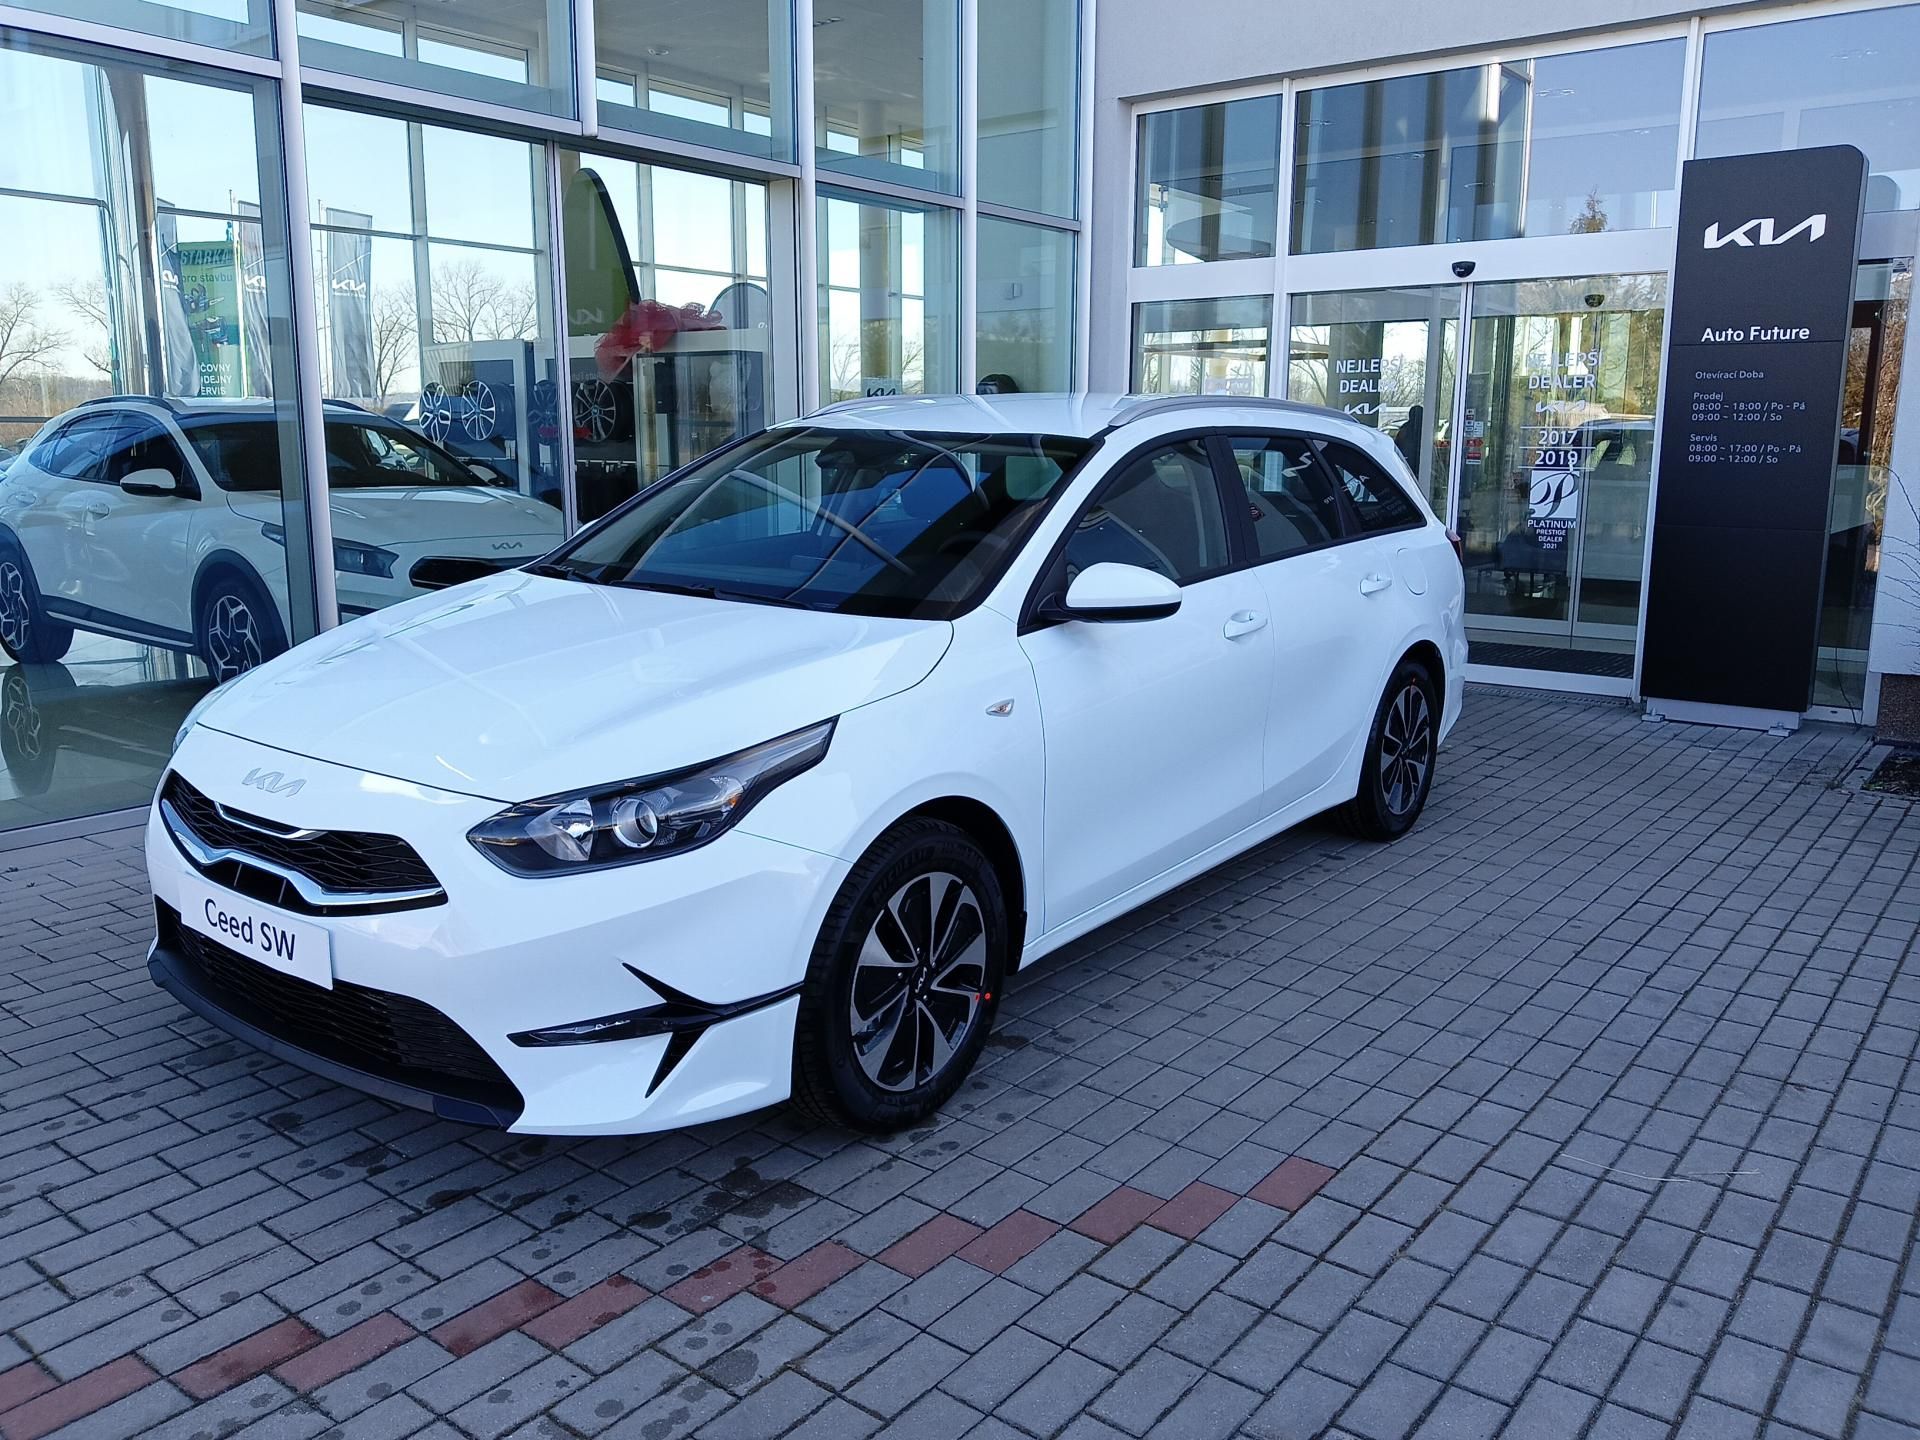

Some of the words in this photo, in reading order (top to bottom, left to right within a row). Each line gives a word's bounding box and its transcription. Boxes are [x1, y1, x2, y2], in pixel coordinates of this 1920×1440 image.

[1704, 214, 1827, 249] KIA
[332, 279, 367, 292] KIA
[1701, 328, 1745, 342] Auto
[1749, 326, 1810, 341] Future
[1695, 371, 1737, 380] Otevírací
[1739, 370, 1765, 379] Doba
[1528, 374, 1596, 390] DEALER
[1693, 392, 1724, 402] Prodej
[1344, 402, 1388, 415] KIA
[1692, 402, 1721, 411] 08:00
[1732, 402, 1761, 411] 18:00
[1771, 402, 1784, 410] Po
[1792, 401, 1806, 410] Pá
[1691, 413, 1720, 421] 09:00
[1732, 413, 1760, 421] 12:00
[1769, 413, 1782, 421] So
[1538, 430, 1578, 445] 2017
[1689, 433, 1718, 442] Servis
[1689, 444, 1718, 453] 08:00
[1729, 444, 1758, 453] 17:00
[1767, 444, 1780, 453] Po
[1788, 444, 1801, 453] Pá
[1534, 450, 1579, 466] 2019
[1688, 454, 1717, 463] 09:00
[1728, 454, 1757, 463] 12:00
[1766, 455, 1778, 464] So
[1527, 519, 1576, 529] PLATINUM
[491, 541, 523, 551] KIA
[241, 767, 307, 798] KIA
[204, 898, 254, 945] Ceed
[260, 921, 295, 961] SW
